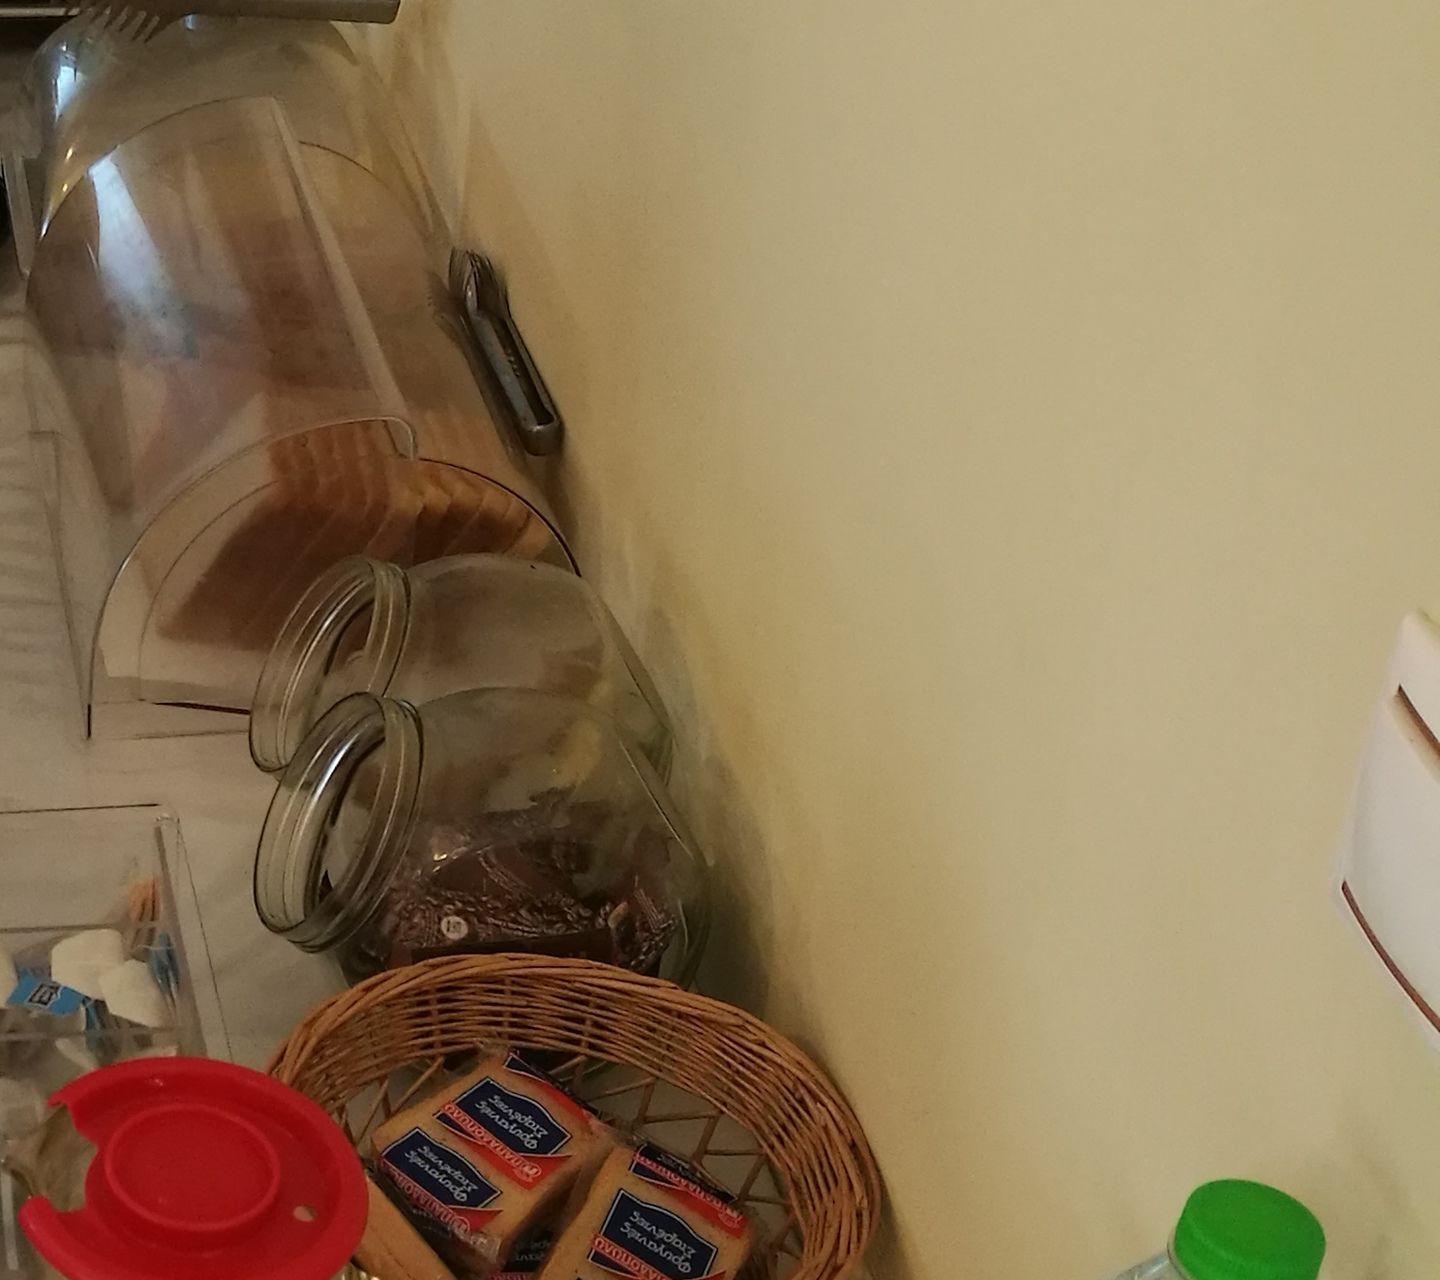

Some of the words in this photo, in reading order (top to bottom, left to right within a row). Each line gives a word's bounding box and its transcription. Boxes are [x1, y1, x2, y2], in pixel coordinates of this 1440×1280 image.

[475, 1100, 539, 1150] Φρυγανιές
[488, 1095, 549, 1139] Σταρένιες
[404, 1150, 469, 1203] Φρυγανιές
[415, 1144, 479, 1193] Σταρένιες
[619, 1220, 693, 1275] Φρυγανιές
[628, 1210, 697, 1260] Σταρένιες
